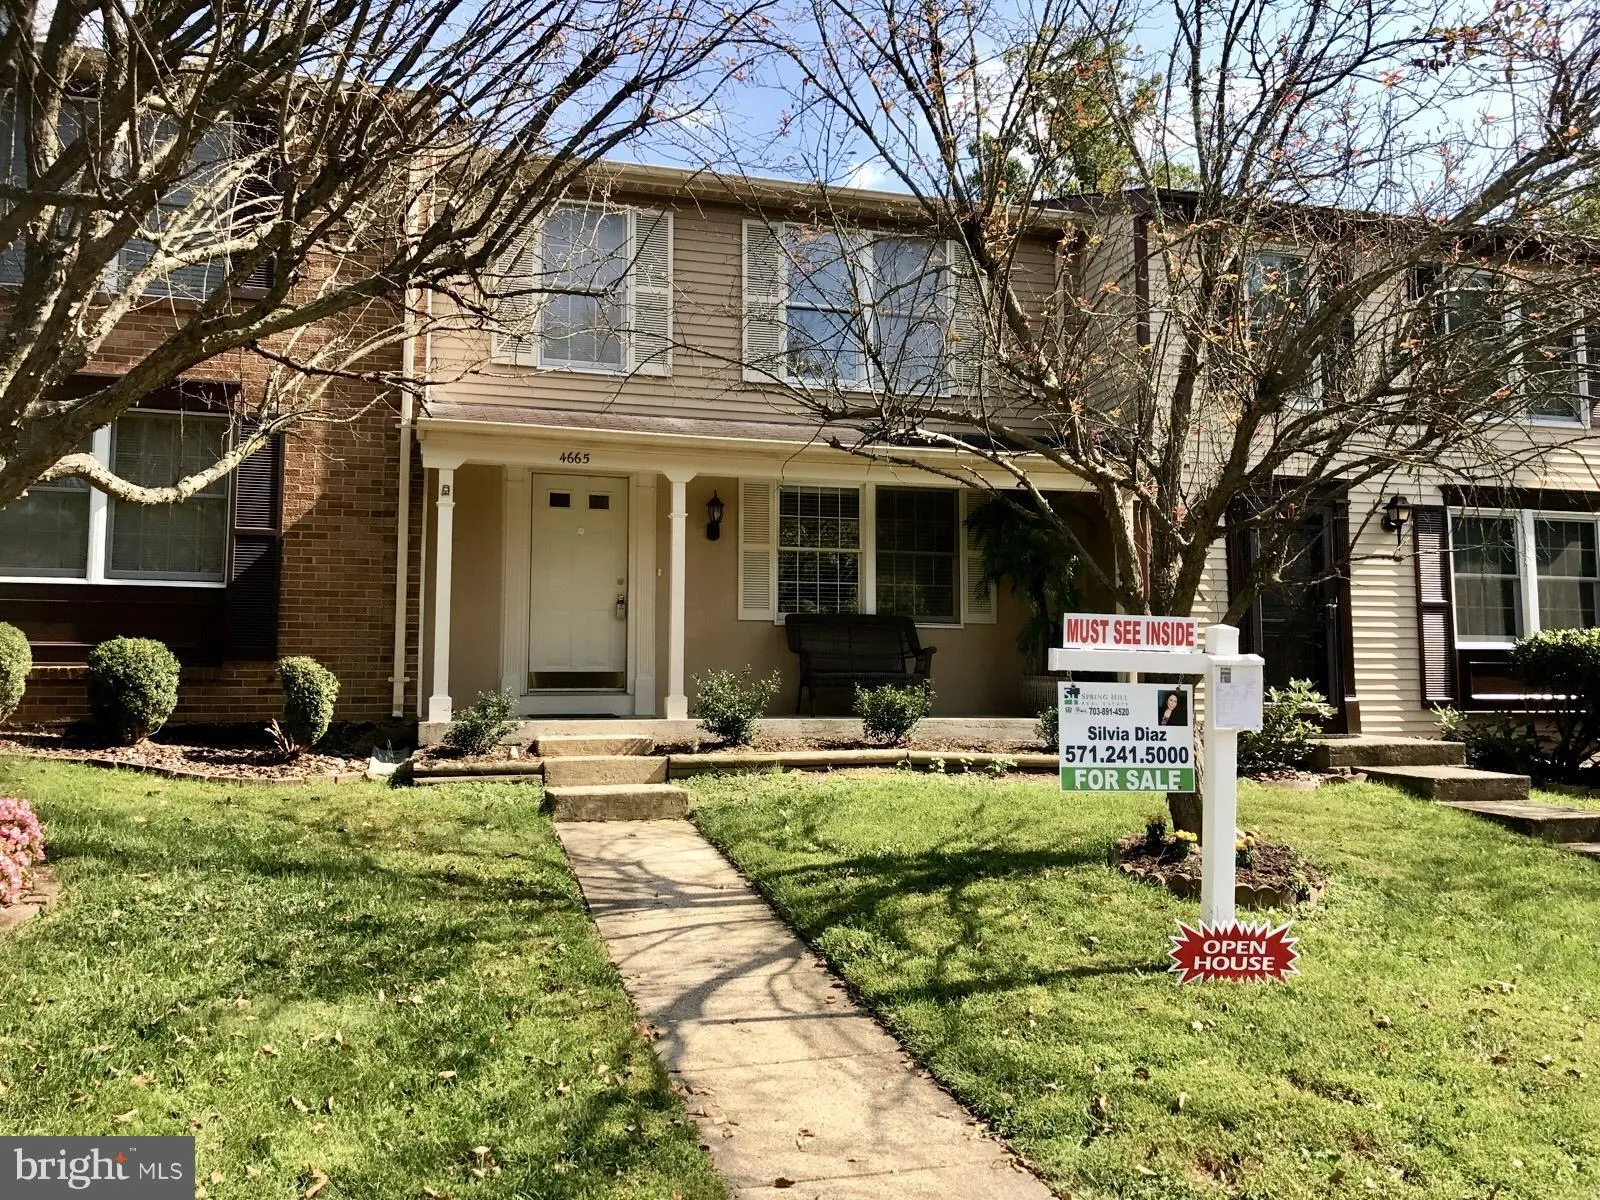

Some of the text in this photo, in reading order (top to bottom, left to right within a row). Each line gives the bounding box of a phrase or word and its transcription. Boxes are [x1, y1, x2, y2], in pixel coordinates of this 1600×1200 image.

[559, 451, 590, 464] 4665
[1067, 619, 1194, 647] MUST SEE INSIDE
[1089, 707, 1130, 716] 703-891-4520
[1088, 726, 1167, 741] Silvia Diaz
[1065, 745, 1189, 764] 571.241.5000
[1075, 769, 1181, 790] FOR SALE
[1203, 940, 1266, 954] OPEN
[1194, 956, 1275, 970] HOUSE
